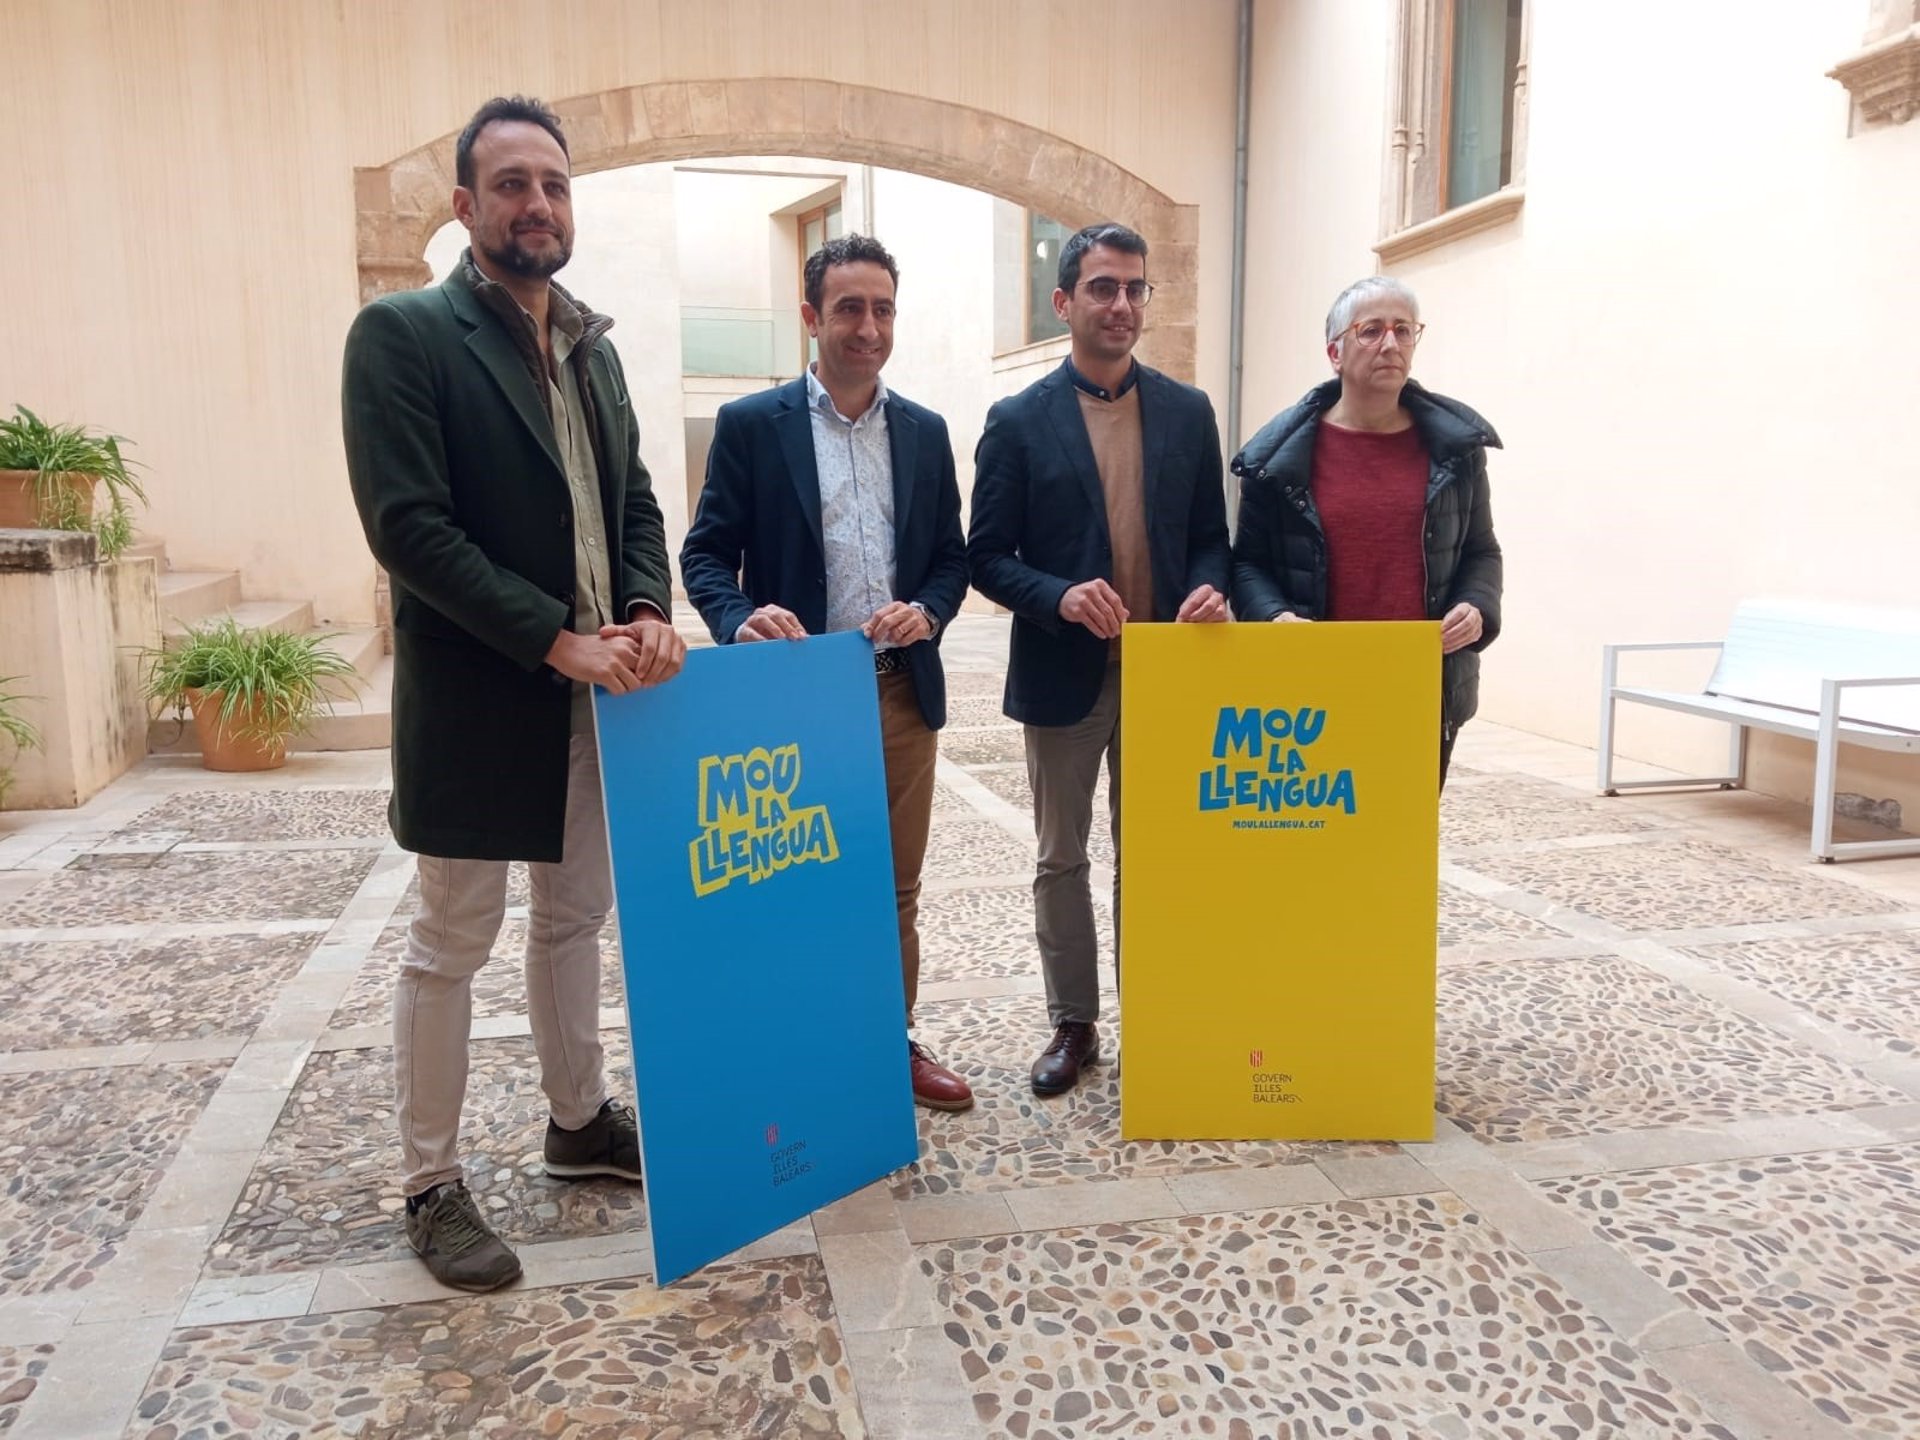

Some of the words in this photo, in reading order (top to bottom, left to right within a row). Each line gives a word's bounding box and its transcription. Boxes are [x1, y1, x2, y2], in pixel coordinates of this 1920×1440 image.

[1213, 707, 1326, 758] MOU
[1268, 744, 1306, 775] LA
[702, 747, 798, 824] MOU
[1199, 764, 1356, 815] LLENGUA
[754, 796, 787, 830] LA
[1232, 820, 1325, 829] MOULALLENGUA.CAT
[693, 810, 836, 892] LLENGUA
[1252, 1073, 1292, 1083] GOVERN
[1253, 1084, 1282, 1093] ILLES
[1253, 1093, 1296, 1103] BALEARS
[770, 1141, 807, 1163] GOVERN
[773, 1156, 798, 1174] ILLES
[773, 1162, 814, 1187] BALEARS
